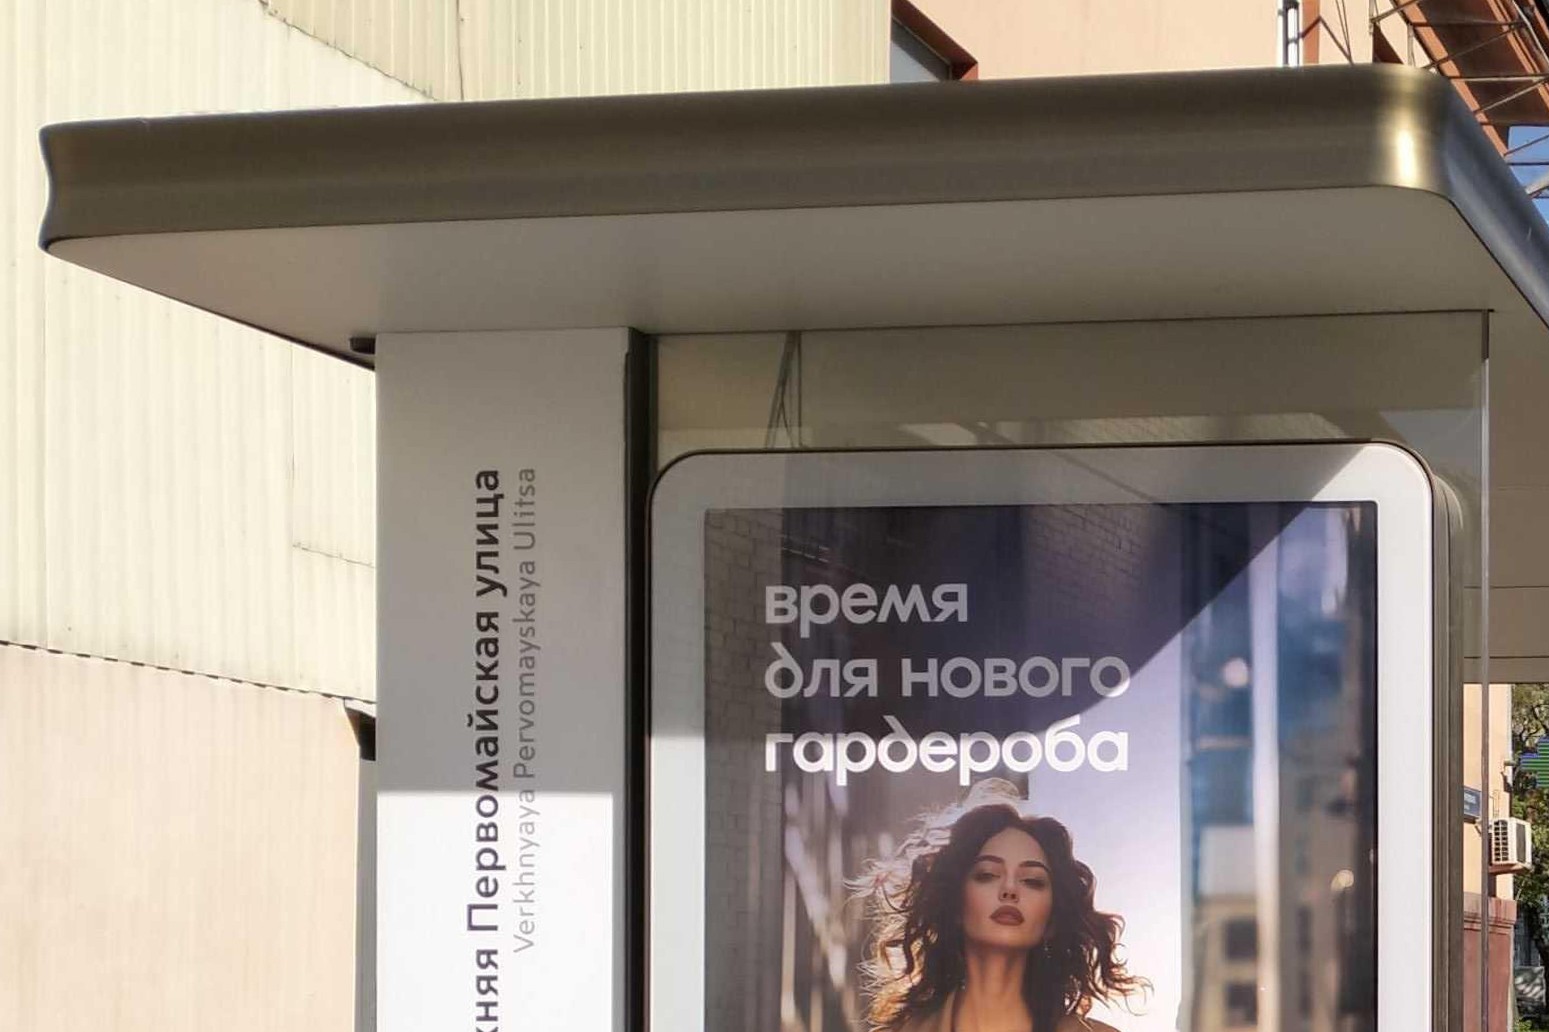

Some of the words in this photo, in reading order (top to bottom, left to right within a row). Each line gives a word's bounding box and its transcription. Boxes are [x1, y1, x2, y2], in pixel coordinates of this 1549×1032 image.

[475, 469, 507, 597] улица
[512, 468, 536, 550] Ulitsa
[765, 583, 968, 638] время
[512, 560, 541, 779] Pervomayskaya
[764, 642, 878, 698] для
[902, 656, 1131, 698] нового
[467, 611, 506, 931] Первомайская
[765, 714, 1129, 786] гардероба
[513, 789, 540, 953] Verkhnyaya
